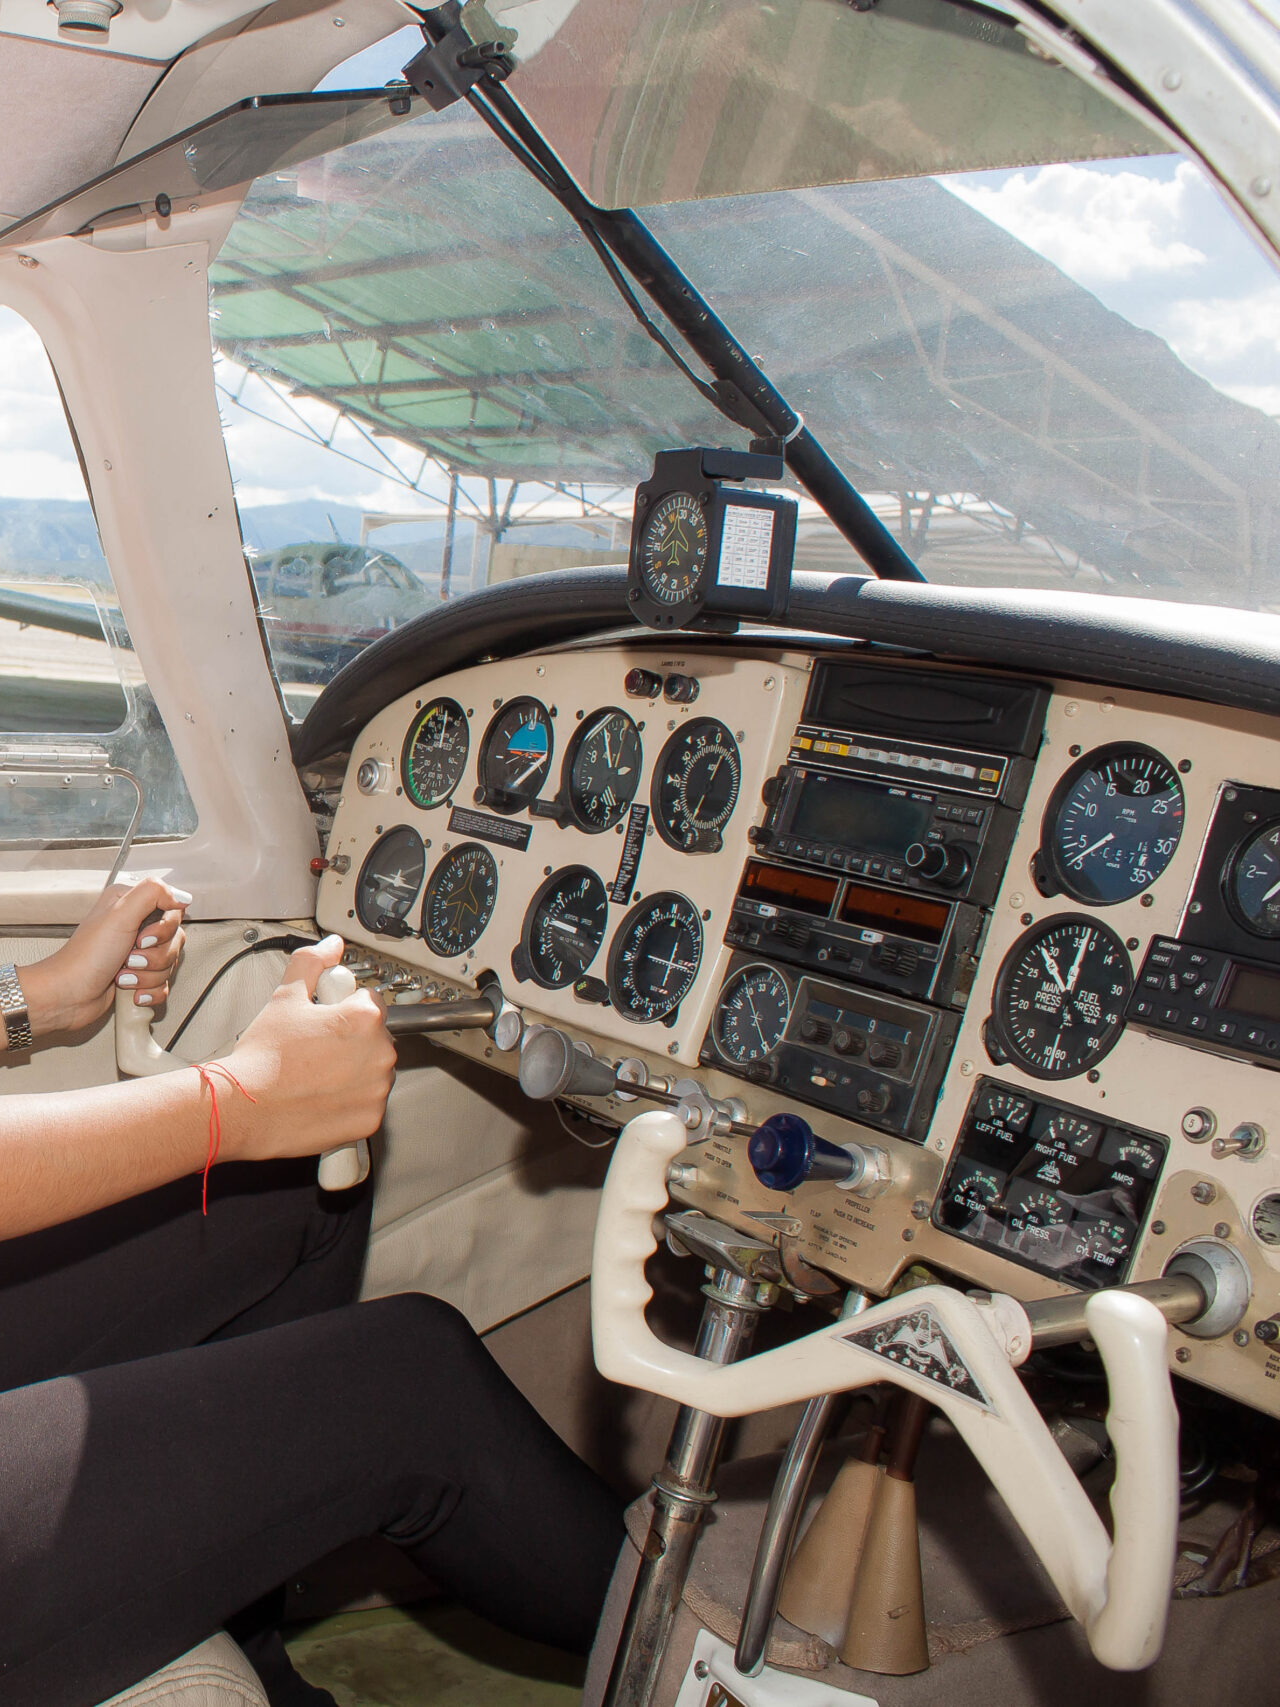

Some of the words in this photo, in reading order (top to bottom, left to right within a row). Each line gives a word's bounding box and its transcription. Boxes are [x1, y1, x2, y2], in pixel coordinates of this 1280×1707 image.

[668, 512, 676, 524] W
[680, 509, 687, 520] 30
[689, 514, 698, 526] 33
[658, 524, 666, 536] 24
[696, 528, 704, 538] N
[697, 548, 704, 556] 3
[654, 560, 662, 569] S
[670, 579, 678, 590] 12
[683, 576, 689, 586] E
[696, 736, 706, 748] 33
[716, 732, 722, 744] 0
[590, 750, 598, 764] 8
[682, 750, 692, 765] 30
[586, 776, 593, 790] 7
[1133, 779, 1150, 794] 20
[1105, 782, 1117, 796] 15
[590, 796, 598, 809] 6
[673, 799, 680, 813] 24
[1152, 799, 1169, 814] 25
[604, 806, 611, 820] 5
[1084, 802, 1098, 817] 10
[1122, 808, 1136, 816] RPM
[1078, 834, 1087, 848] 5
[1270, 832, 1280, 846] 4
[1154, 839, 1172, 854] 30
[1073, 858, 1084, 870] 3
[479, 865, 486, 876] 24
[1130, 868, 1146, 884] 35
[1246, 864, 1256, 878] 2
[446, 882, 454, 892] 15
[486, 877, 494, 886] W
[486, 894, 494, 906] 30
[556, 891, 563, 903] 5
[441, 900, 448, 908] 12
[672, 904, 678, 914] N
[480, 912, 487, 924] 33
[650, 908, 660, 920] 33
[440, 917, 448, 926] E
[543, 916, 550, 928] 0
[470, 928, 476, 938] N
[634, 926, 644, 938] 30
[540, 944, 546, 955] 5
[1049, 946, 1060, 957] 30
[1088, 941, 1096, 951] 0
[1158, 941, 1182, 952] GARMIN
[624, 950, 632, 961] W
[1104, 954, 1114, 966] 14
[1152, 954, 1170, 964] IDENT
[1191, 954, 1202, 963] ON
[552, 968, 562, 981] 10
[1028, 968, 1040, 978] 25
[1183, 972, 1196, 980] ALT
[622, 976, 630, 988] 24
[1146, 975, 1158, 984] VFR
[758, 984, 766, 992] 33
[770, 986, 778, 996] N
[1111, 984, 1123, 996] 30
[1194, 982, 1208, 996] OFF
[1034, 991, 1062, 1008] PRESS
[1078, 990, 1100, 1006] FUEL
[732, 1000, 744, 1010] W
[1018, 1000, 1030, 1010] 20
[1138, 1003, 1144, 1012] 0
[648, 1008, 654, 1018] S
[835, 1009, 844, 1023] 7
[1106, 1013, 1118, 1024] 45
[1166, 1010, 1172, 1018] 1
[730, 1016, 738, 1026] 24
[868, 1019, 876, 1034] 9
[1192, 1016, 1200, 1026] 2
[1026, 1028, 1036, 1038] 15
[1220, 1024, 1228, 1034] 3
[1248, 1031, 1256, 1040] 4
[738, 1045, 746, 1056] S
[750, 1049, 758, 1058] 15
[1044, 1045, 1052, 1056] 10
[1055, 1050, 1066, 1060] 80
[1188, 1118, 1195, 1128] 5
[976, 1121, 996, 1134] LEFT
[996, 1129, 1014, 1143] FUEL
[712, 1142, 732, 1154] THROTTLE
[1035, 1142, 1058, 1156] RIGHT
[1058, 1151, 1078, 1166] FUEL
[704, 1152, 715, 1161] PUSH
[721, 1159, 732, 1168] OPEN
[1111, 1171, 1134, 1186] AMPS
[716, 1191, 727, 1200] GEAR
[954, 1194, 966, 1206] OIL
[846, 1198, 871, 1214] PROPELLER
[810, 1209, 822, 1218] FLAP
[833, 1208, 846, 1218] PUSH
[853, 1217, 876, 1231] INCREASE
[1012, 1218, 1024, 1230] OIL
[1099, 1219, 1110, 1227] 200
[1114, 1225, 1125, 1234] 400
[1076, 1244, 1090, 1257] CYL
[1112, 1246, 1123, 1254] 600
[1264, 1370, 1276, 1379] BAR
